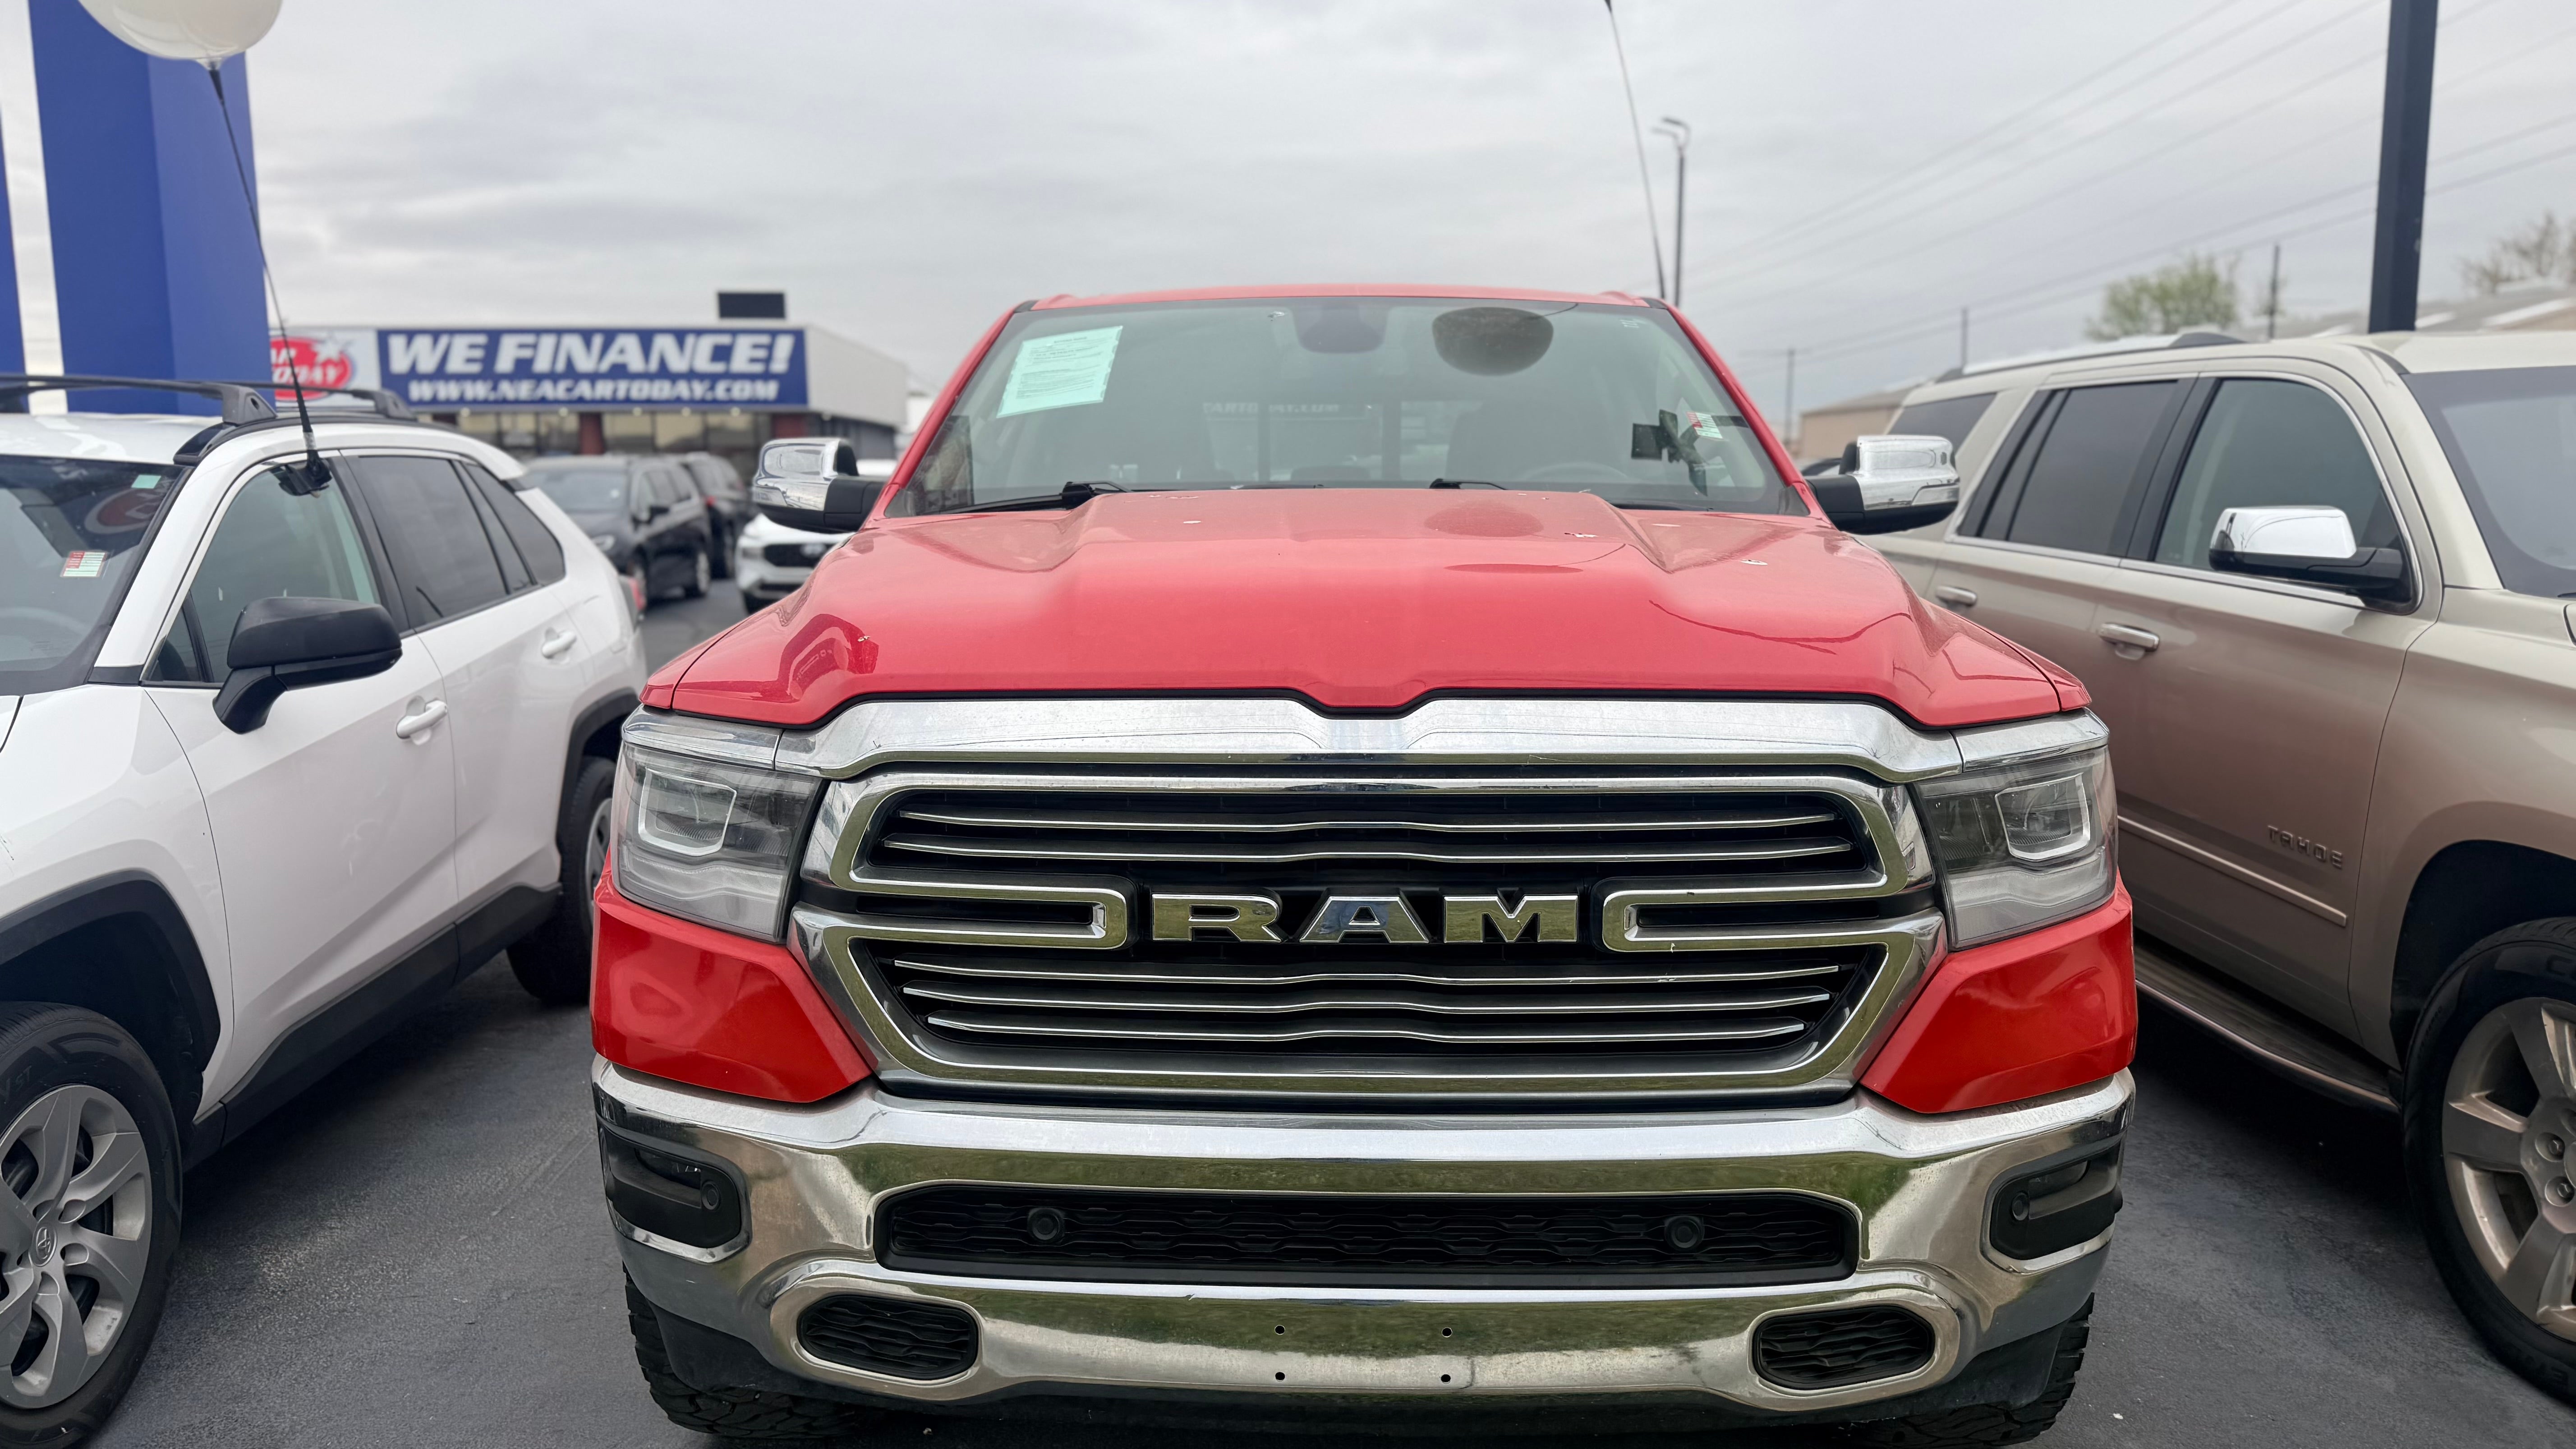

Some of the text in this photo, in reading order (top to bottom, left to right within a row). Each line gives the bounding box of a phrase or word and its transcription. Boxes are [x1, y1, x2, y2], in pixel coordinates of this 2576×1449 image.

[388, 332, 795, 374] WE FINANCE!
[408, 379, 779, 401] WWW.NEACARTODAY.COM
[2267, 825, 2342, 870] TAHOE
[1151, 893, 1579, 943] RAM
